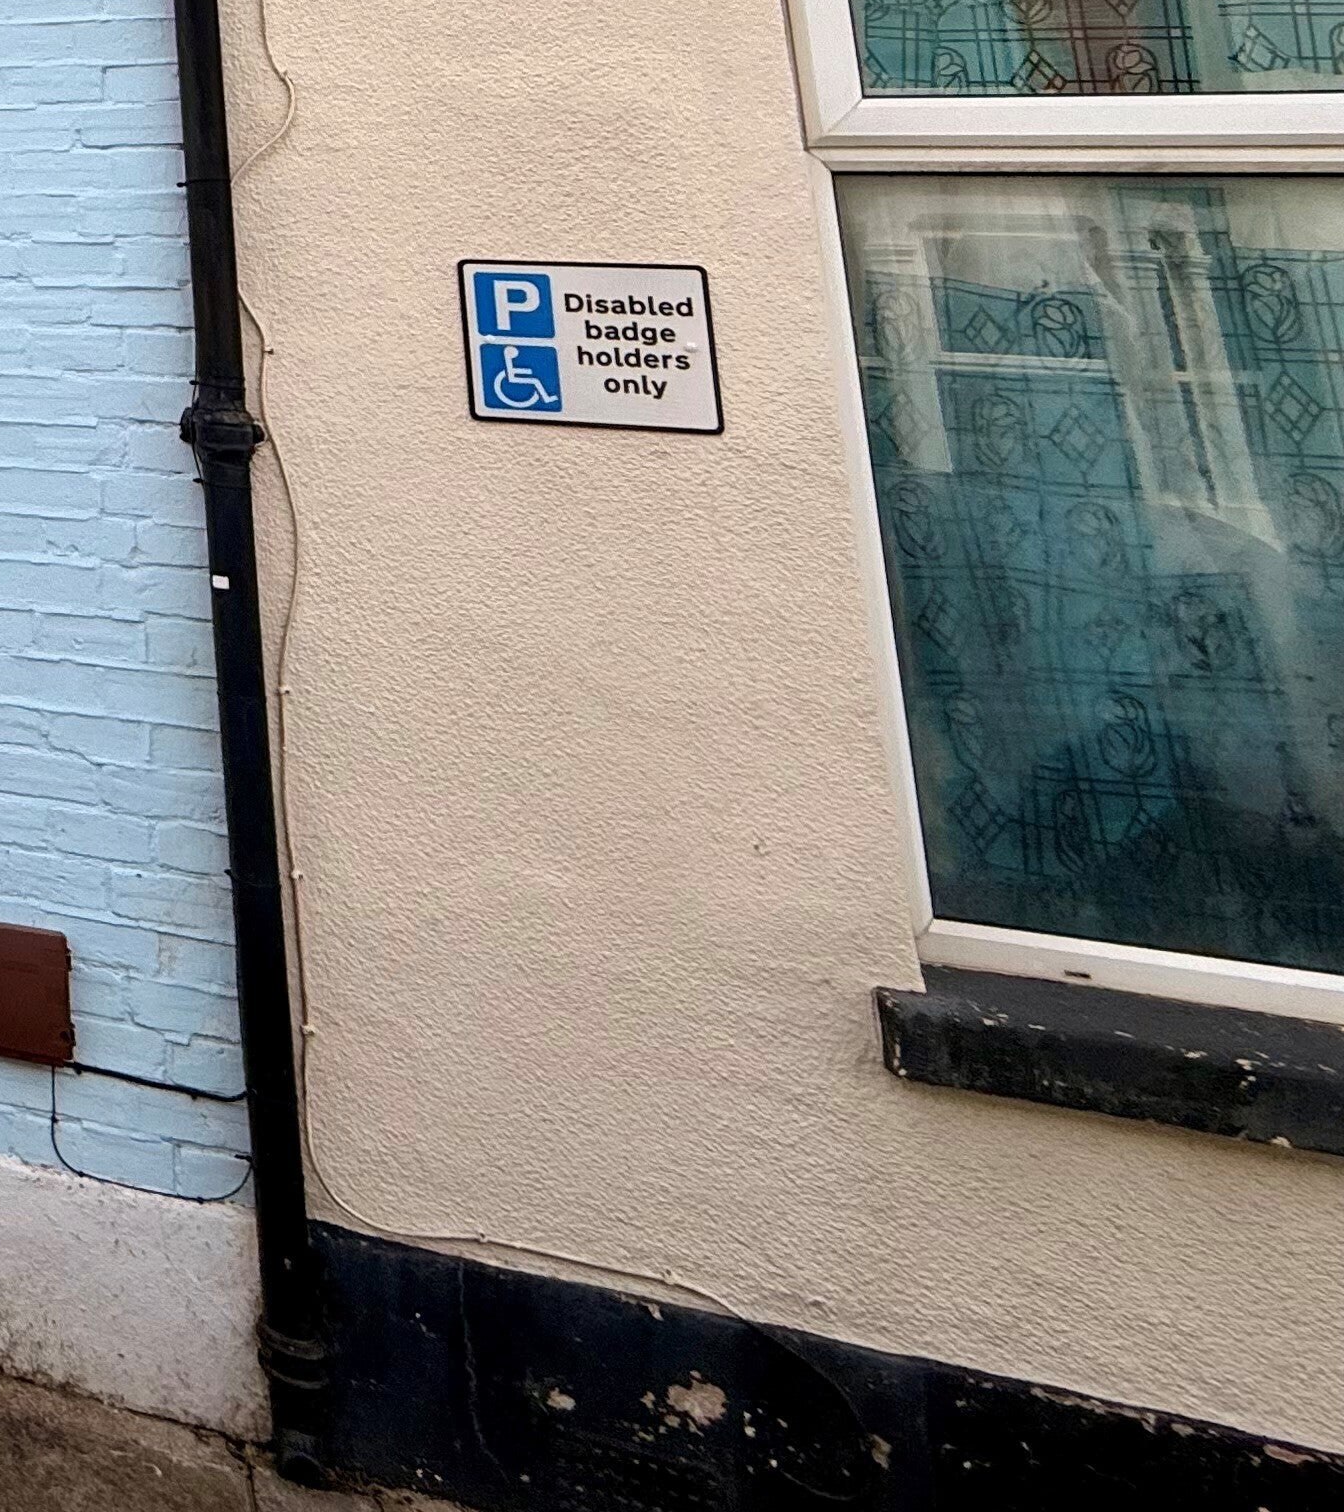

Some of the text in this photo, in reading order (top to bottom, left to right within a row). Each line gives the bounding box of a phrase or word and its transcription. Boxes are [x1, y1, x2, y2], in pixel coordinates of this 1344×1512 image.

[493, 280, 540, 330] P
[564, 293, 694, 317] Disabled
[585, 320, 676, 345] badge
[577, 346, 690, 370] holders
[603, 375, 667, 399] only
